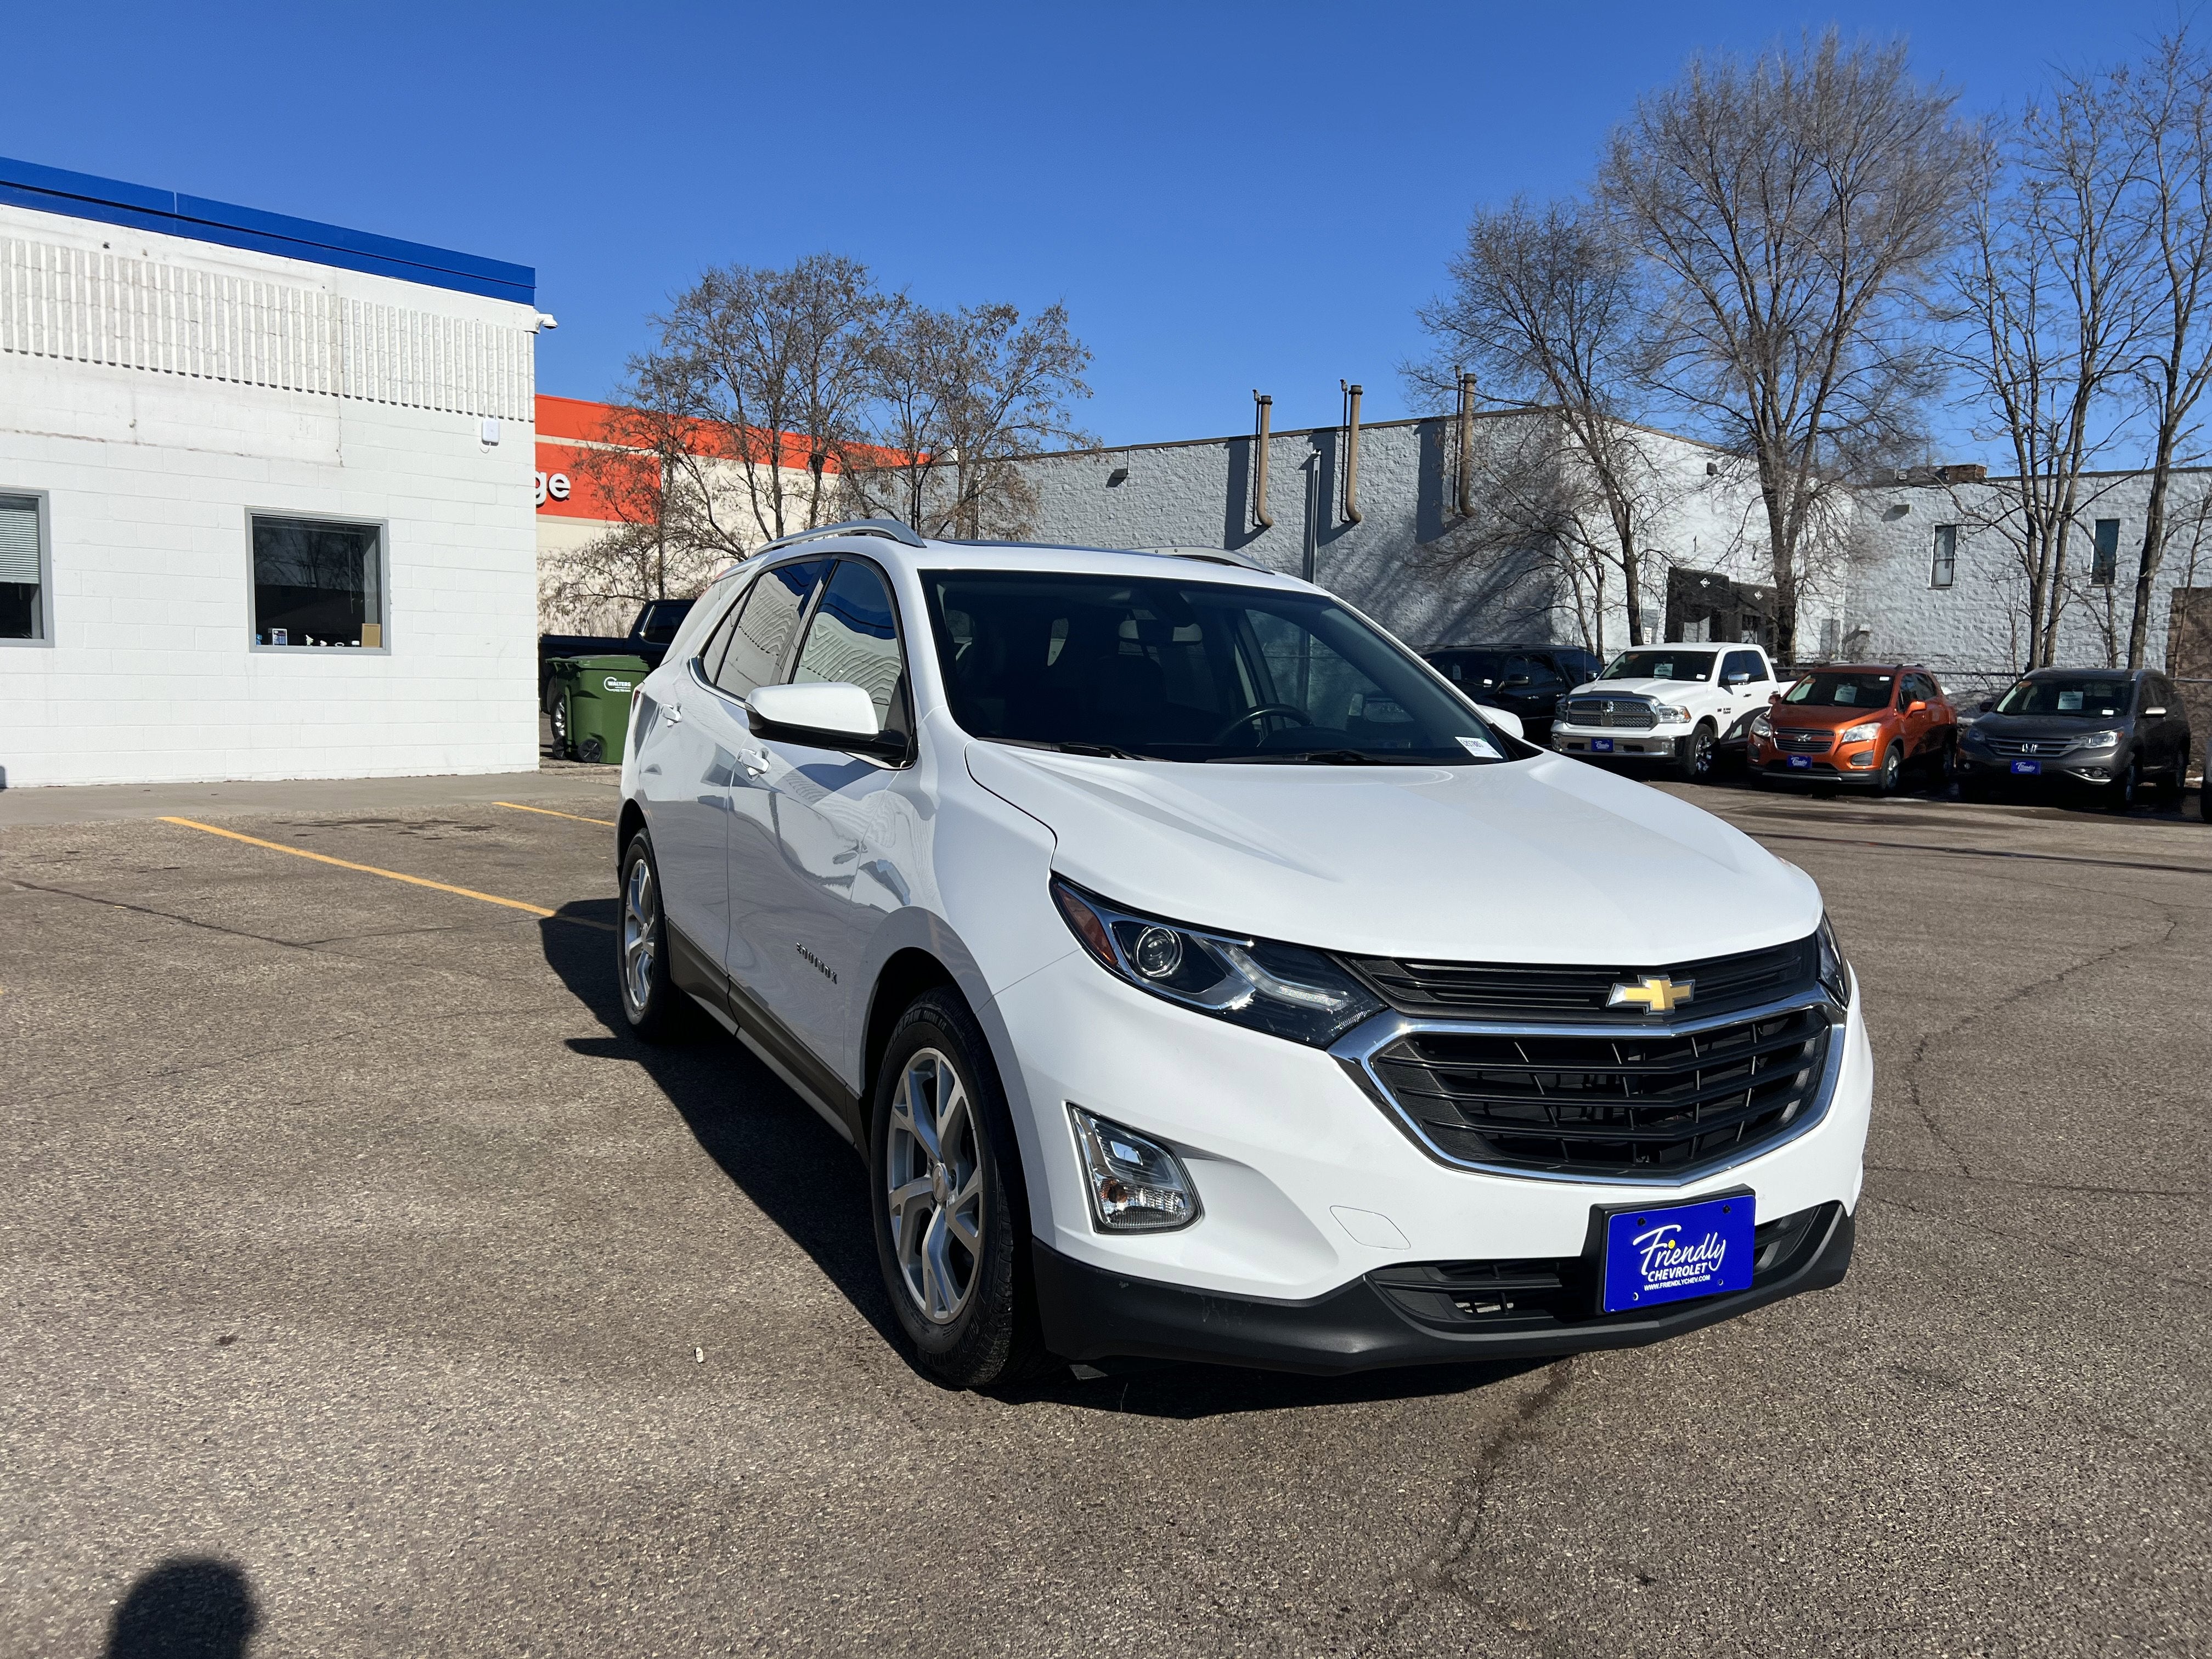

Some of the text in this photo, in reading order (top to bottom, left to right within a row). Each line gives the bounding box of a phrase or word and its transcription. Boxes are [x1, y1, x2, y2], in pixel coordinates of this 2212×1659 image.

[1632, 1224, 1726, 1276] Friendly
[1647, 1262, 1708, 1282] CHEVROLET
[1644, 1274, 1711, 1291] WWW.FRIENDLYCHEV.COM
